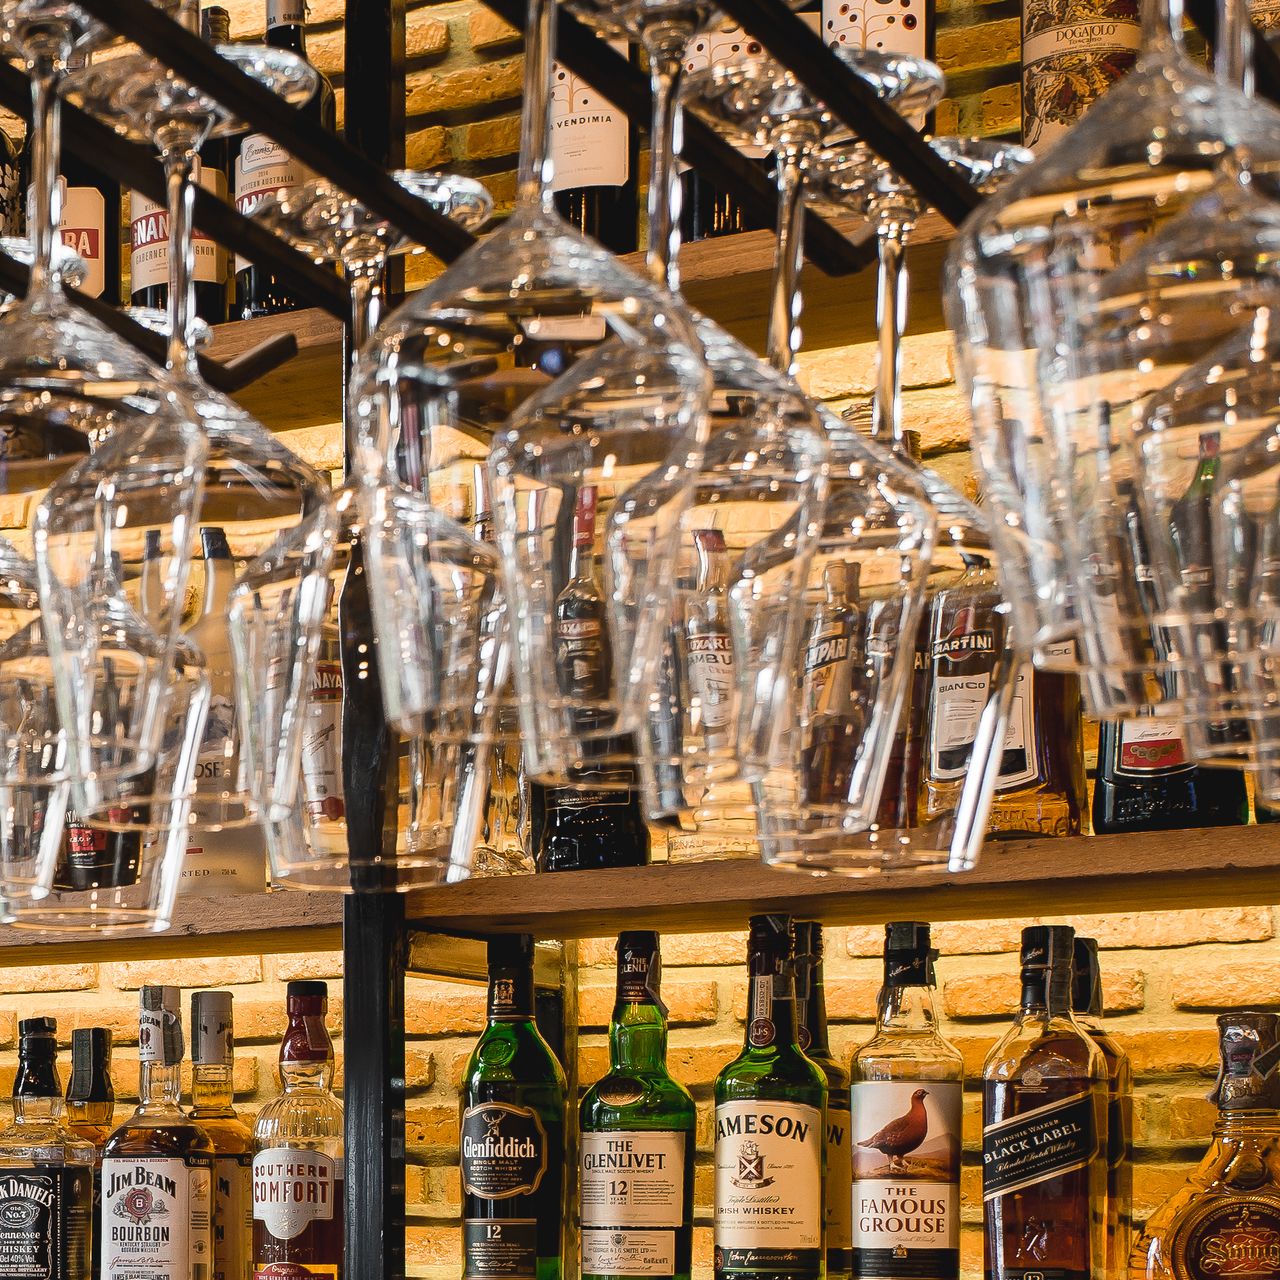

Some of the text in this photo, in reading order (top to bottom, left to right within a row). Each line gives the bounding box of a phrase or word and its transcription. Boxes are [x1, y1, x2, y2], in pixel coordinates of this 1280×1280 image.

[1055, 24, 1117, 42] DOGAJOLO
[557, 115, 612, 128] VENDIMIA
[261, 175, 295, 186] AUSTRALIA
[135, 246, 168, 265] CABERNET
[933, 635, 993, 656] MARTINI
[939, 681, 986, 693] BIANCO
[463, 1135, 535, 1158] Glenfiddich
[606, 1140, 633, 1152] THE
[983, 1122, 1082, 1164] BLACK LABEL
[584, 1153, 666, 1170] GLENLIVET
[254, 1163, 328, 1178] SOUTHERN
[106, 1166, 178, 1199] JIM BEAM
[608, 1180, 628, 1196] 12
[9, 1179, 56, 1207] DANIEL'S
[254, 1180, 330, 1203] COMFORT
[884, 1187, 918, 1196] THE
[5, 1210, 27, 1219] No.7
[717, 1207, 795, 1215] IRISH WHISKEY
[860, 1198, 946, 1215] FAMOUS
[485, 1225, 502, 1239] 12
[859, 1217, 945, 1233] GROUSE
[111, 1226, 170, 1242] BOURBON
